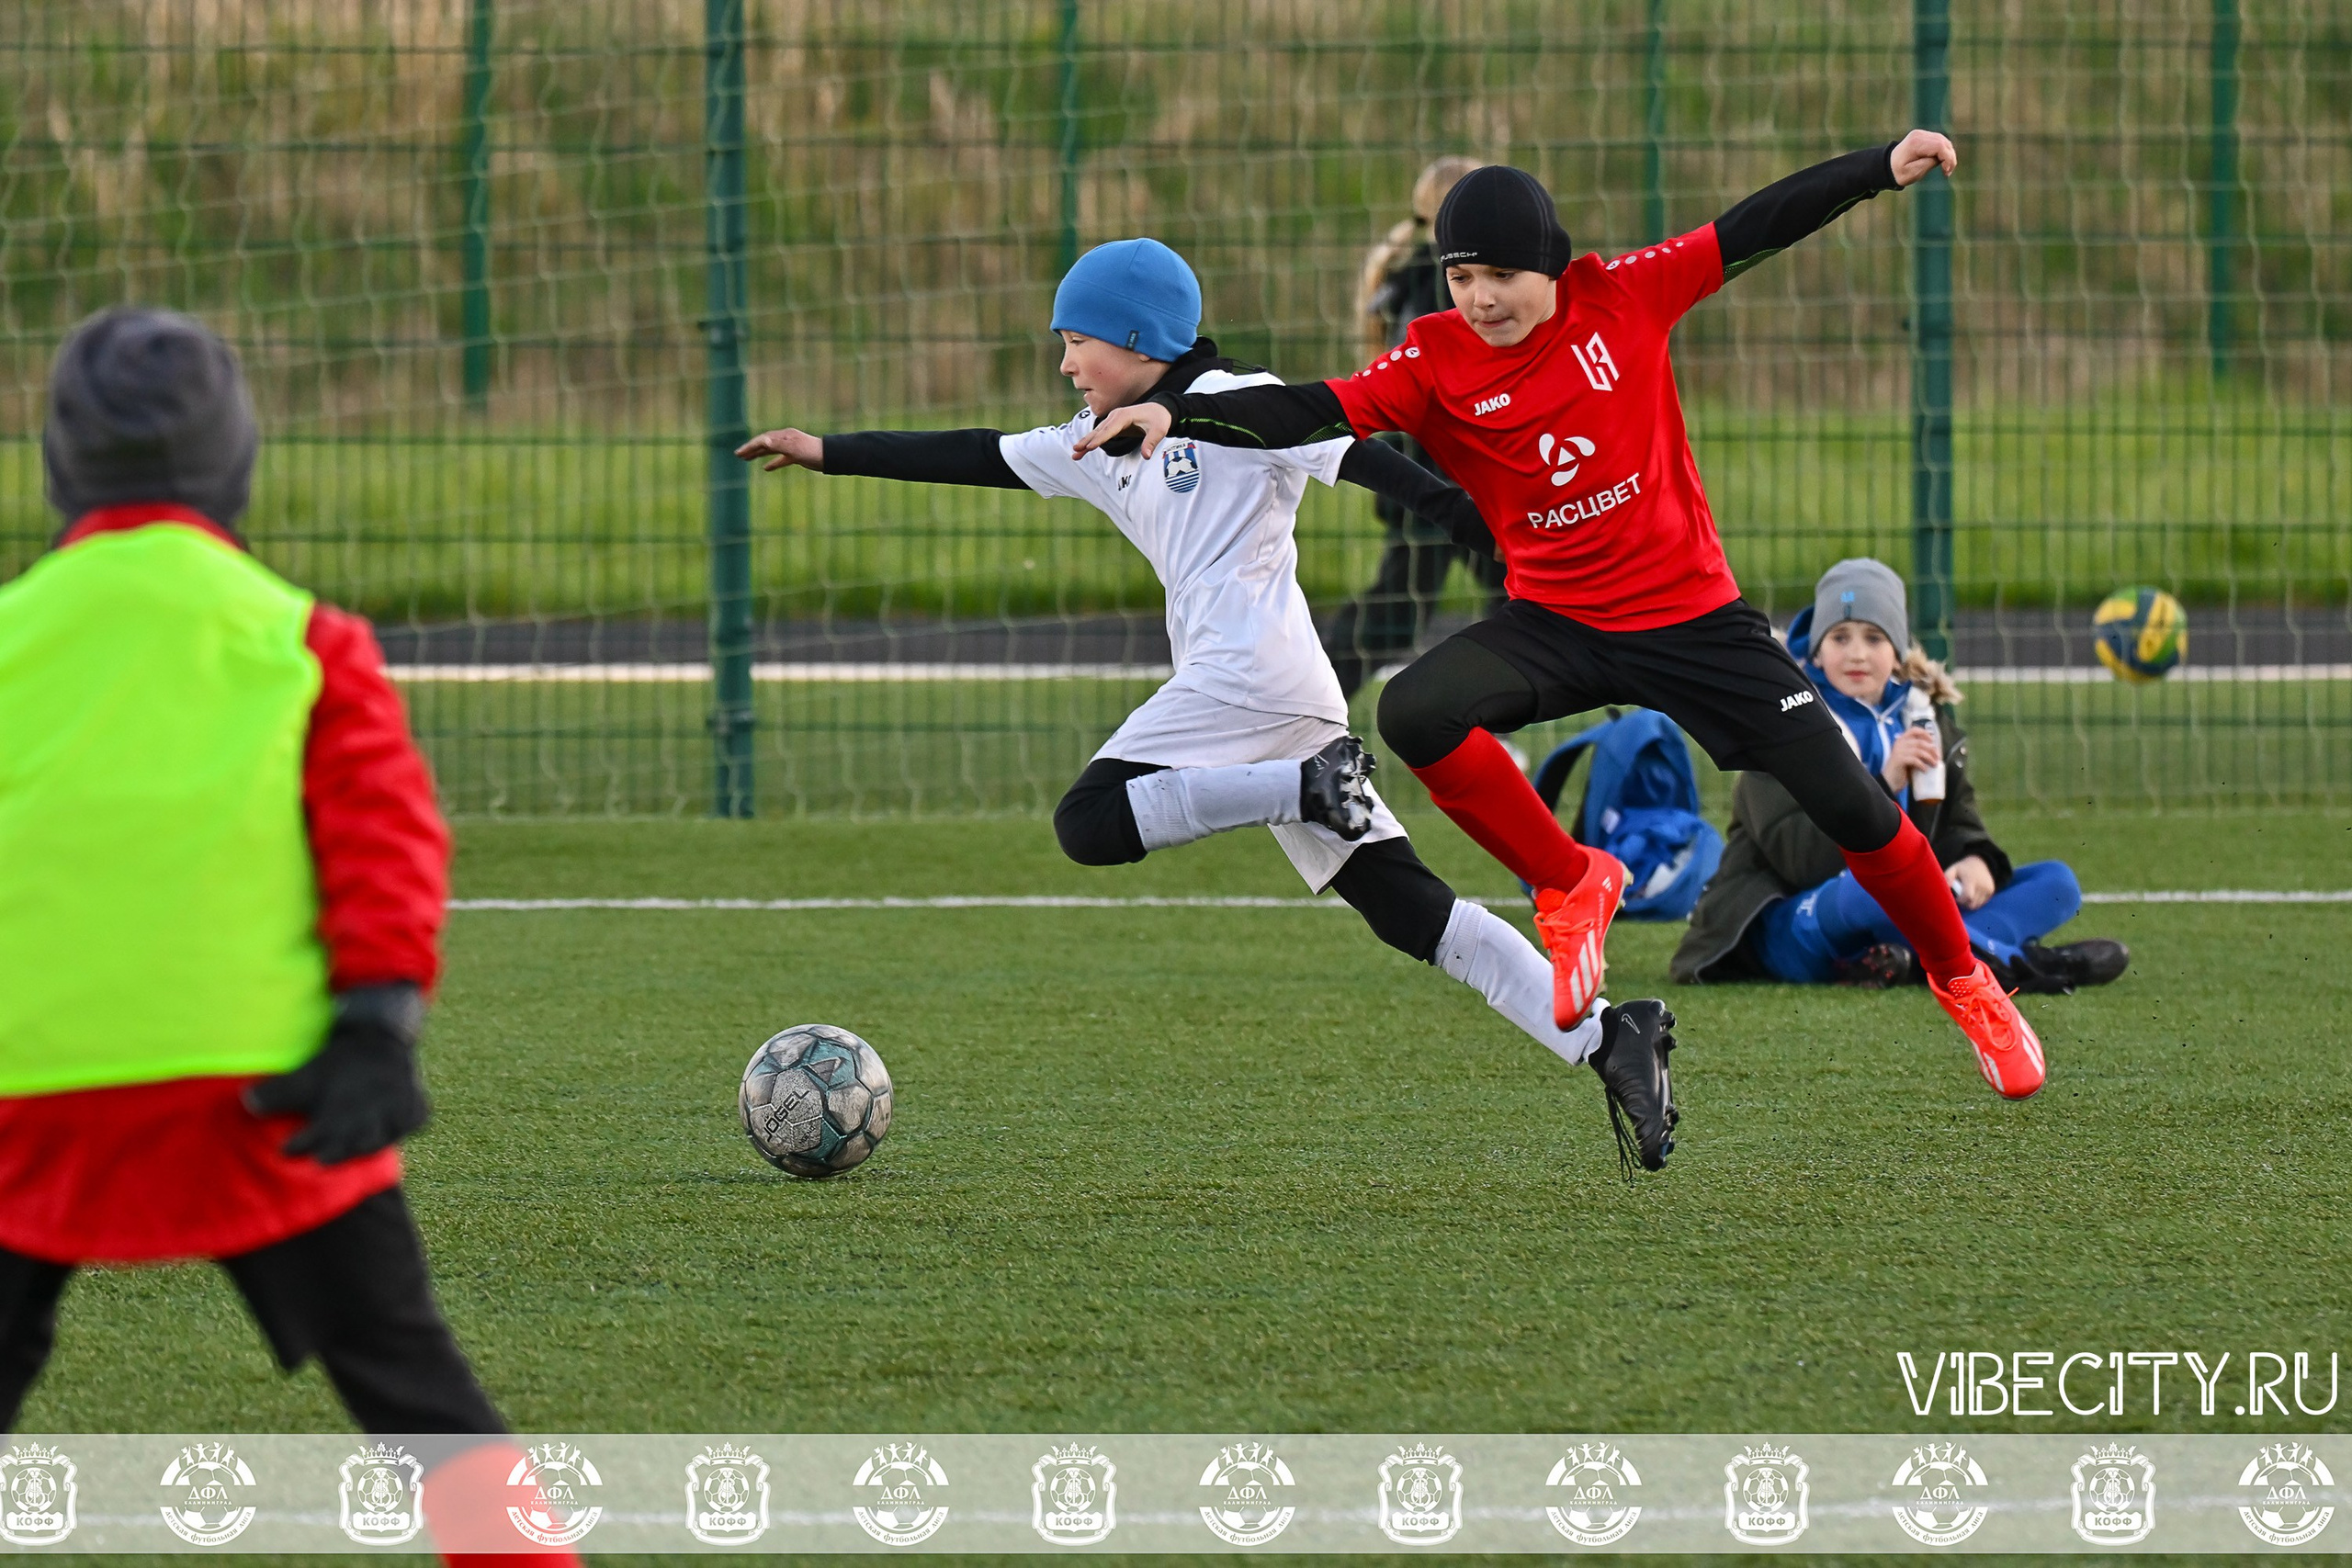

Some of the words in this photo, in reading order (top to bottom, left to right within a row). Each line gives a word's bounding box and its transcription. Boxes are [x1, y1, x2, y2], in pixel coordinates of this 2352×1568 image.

[1474, 393, 1511, 416] JAKO
[1527, 472, 1641, 529] РАСЦВЕТ
[1780, 690, 1814, 712] JAKO
